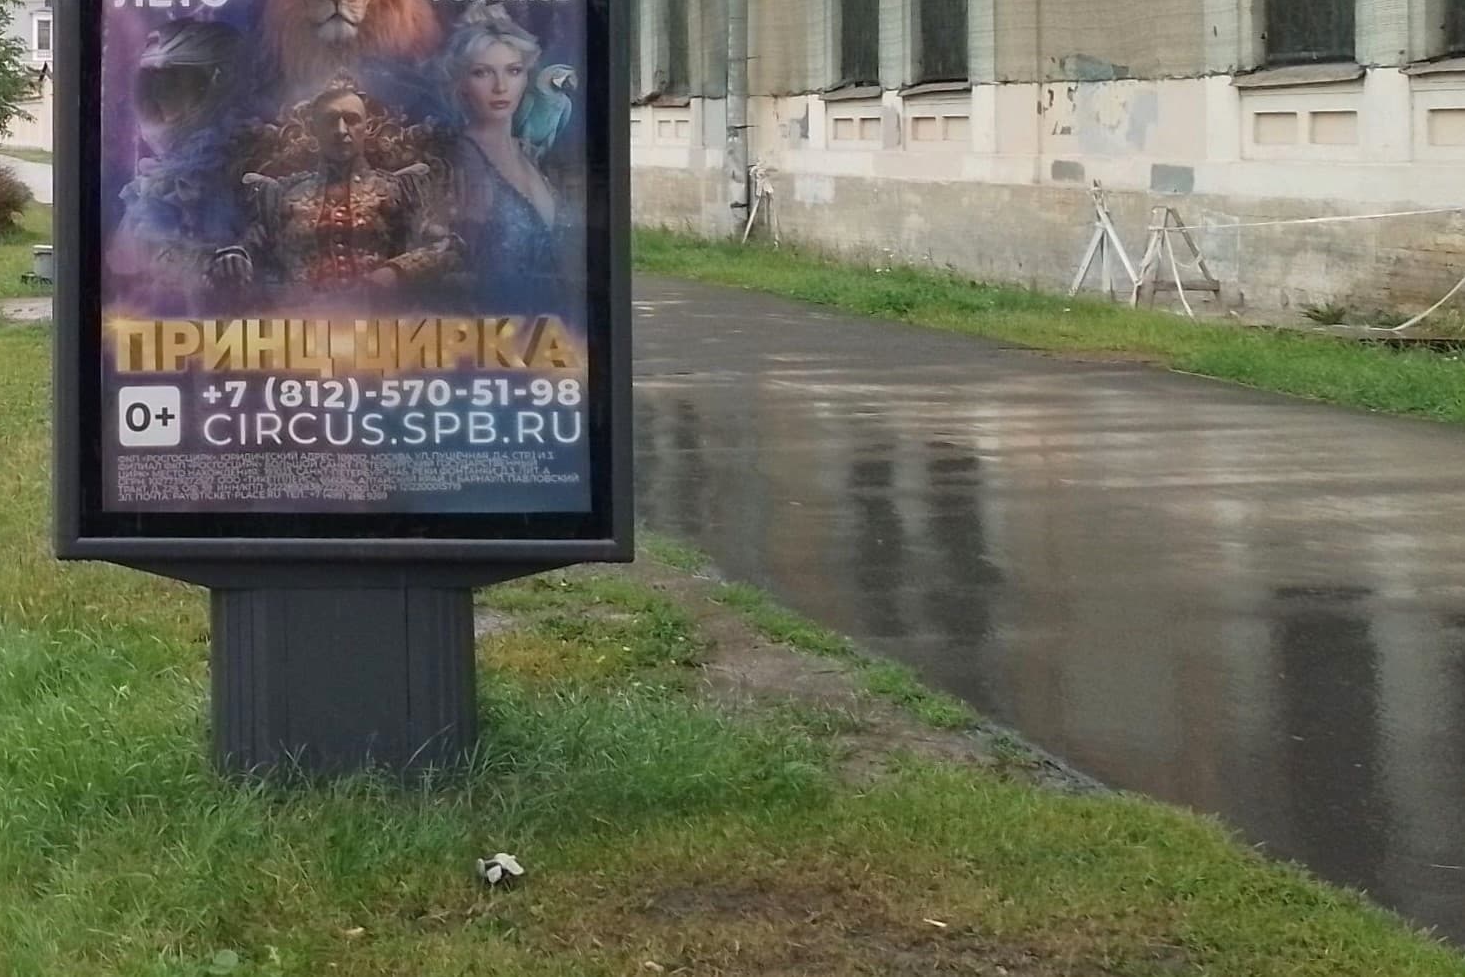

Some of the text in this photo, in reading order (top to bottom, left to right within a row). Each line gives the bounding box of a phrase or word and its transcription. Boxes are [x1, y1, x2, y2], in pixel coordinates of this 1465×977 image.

[116, 316, 583, 379] ПРИНЦ ЦИРКА
[202, 377, 582, 412] +7 (812)-570-51-98
[125, 402, 175, 432] 0+
[203, 411, 582, 446] CIRCUS.SPB.RU
